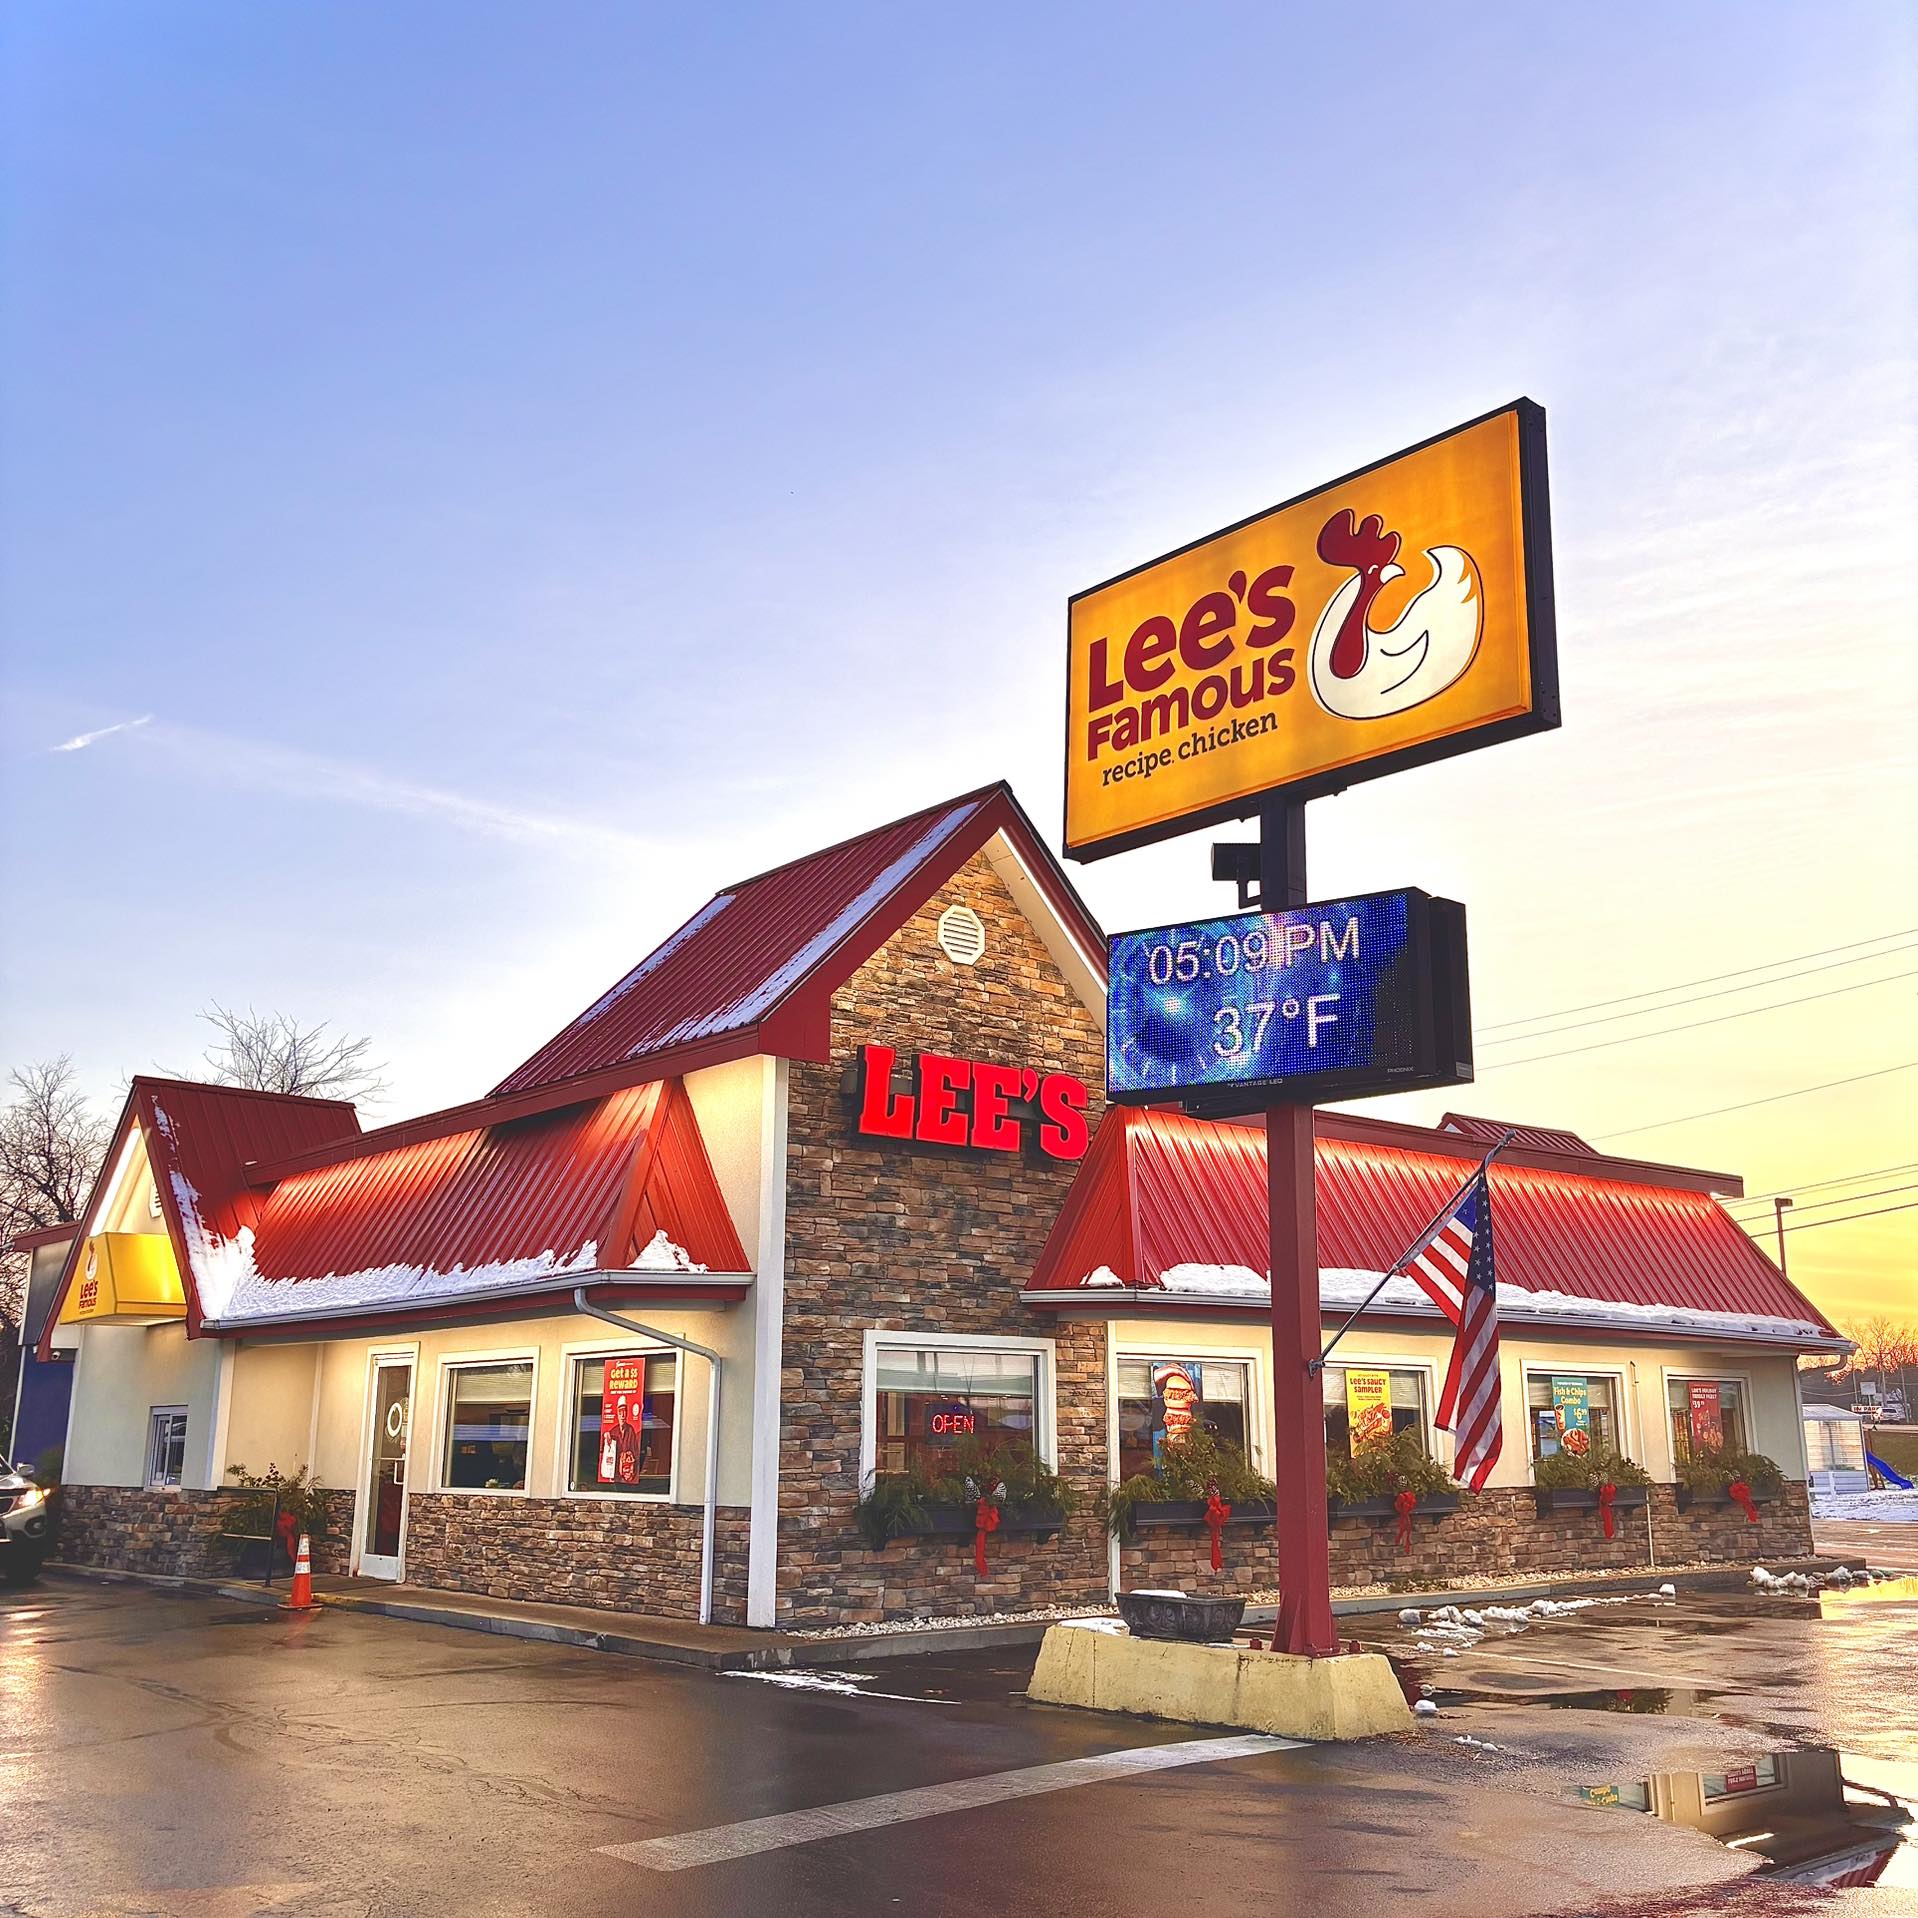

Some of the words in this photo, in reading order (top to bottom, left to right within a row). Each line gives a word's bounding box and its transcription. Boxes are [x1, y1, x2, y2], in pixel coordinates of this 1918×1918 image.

[1088, 564, 1297, 713] Lee's
[1086, 648, 1297, 762] Famous
[1101, 750, 1173, 787] recipe
[1177, 711, 1279, 761] chicken
[1148, 930, 1270, 986] 05:09
[1285, 916, 1360, 964] PM
[1213, 993, 1342, 1057] 37°F
[858, 1043, 1090, 1161] LEE'S
[931, 1413, 975, 1435] OPEN
